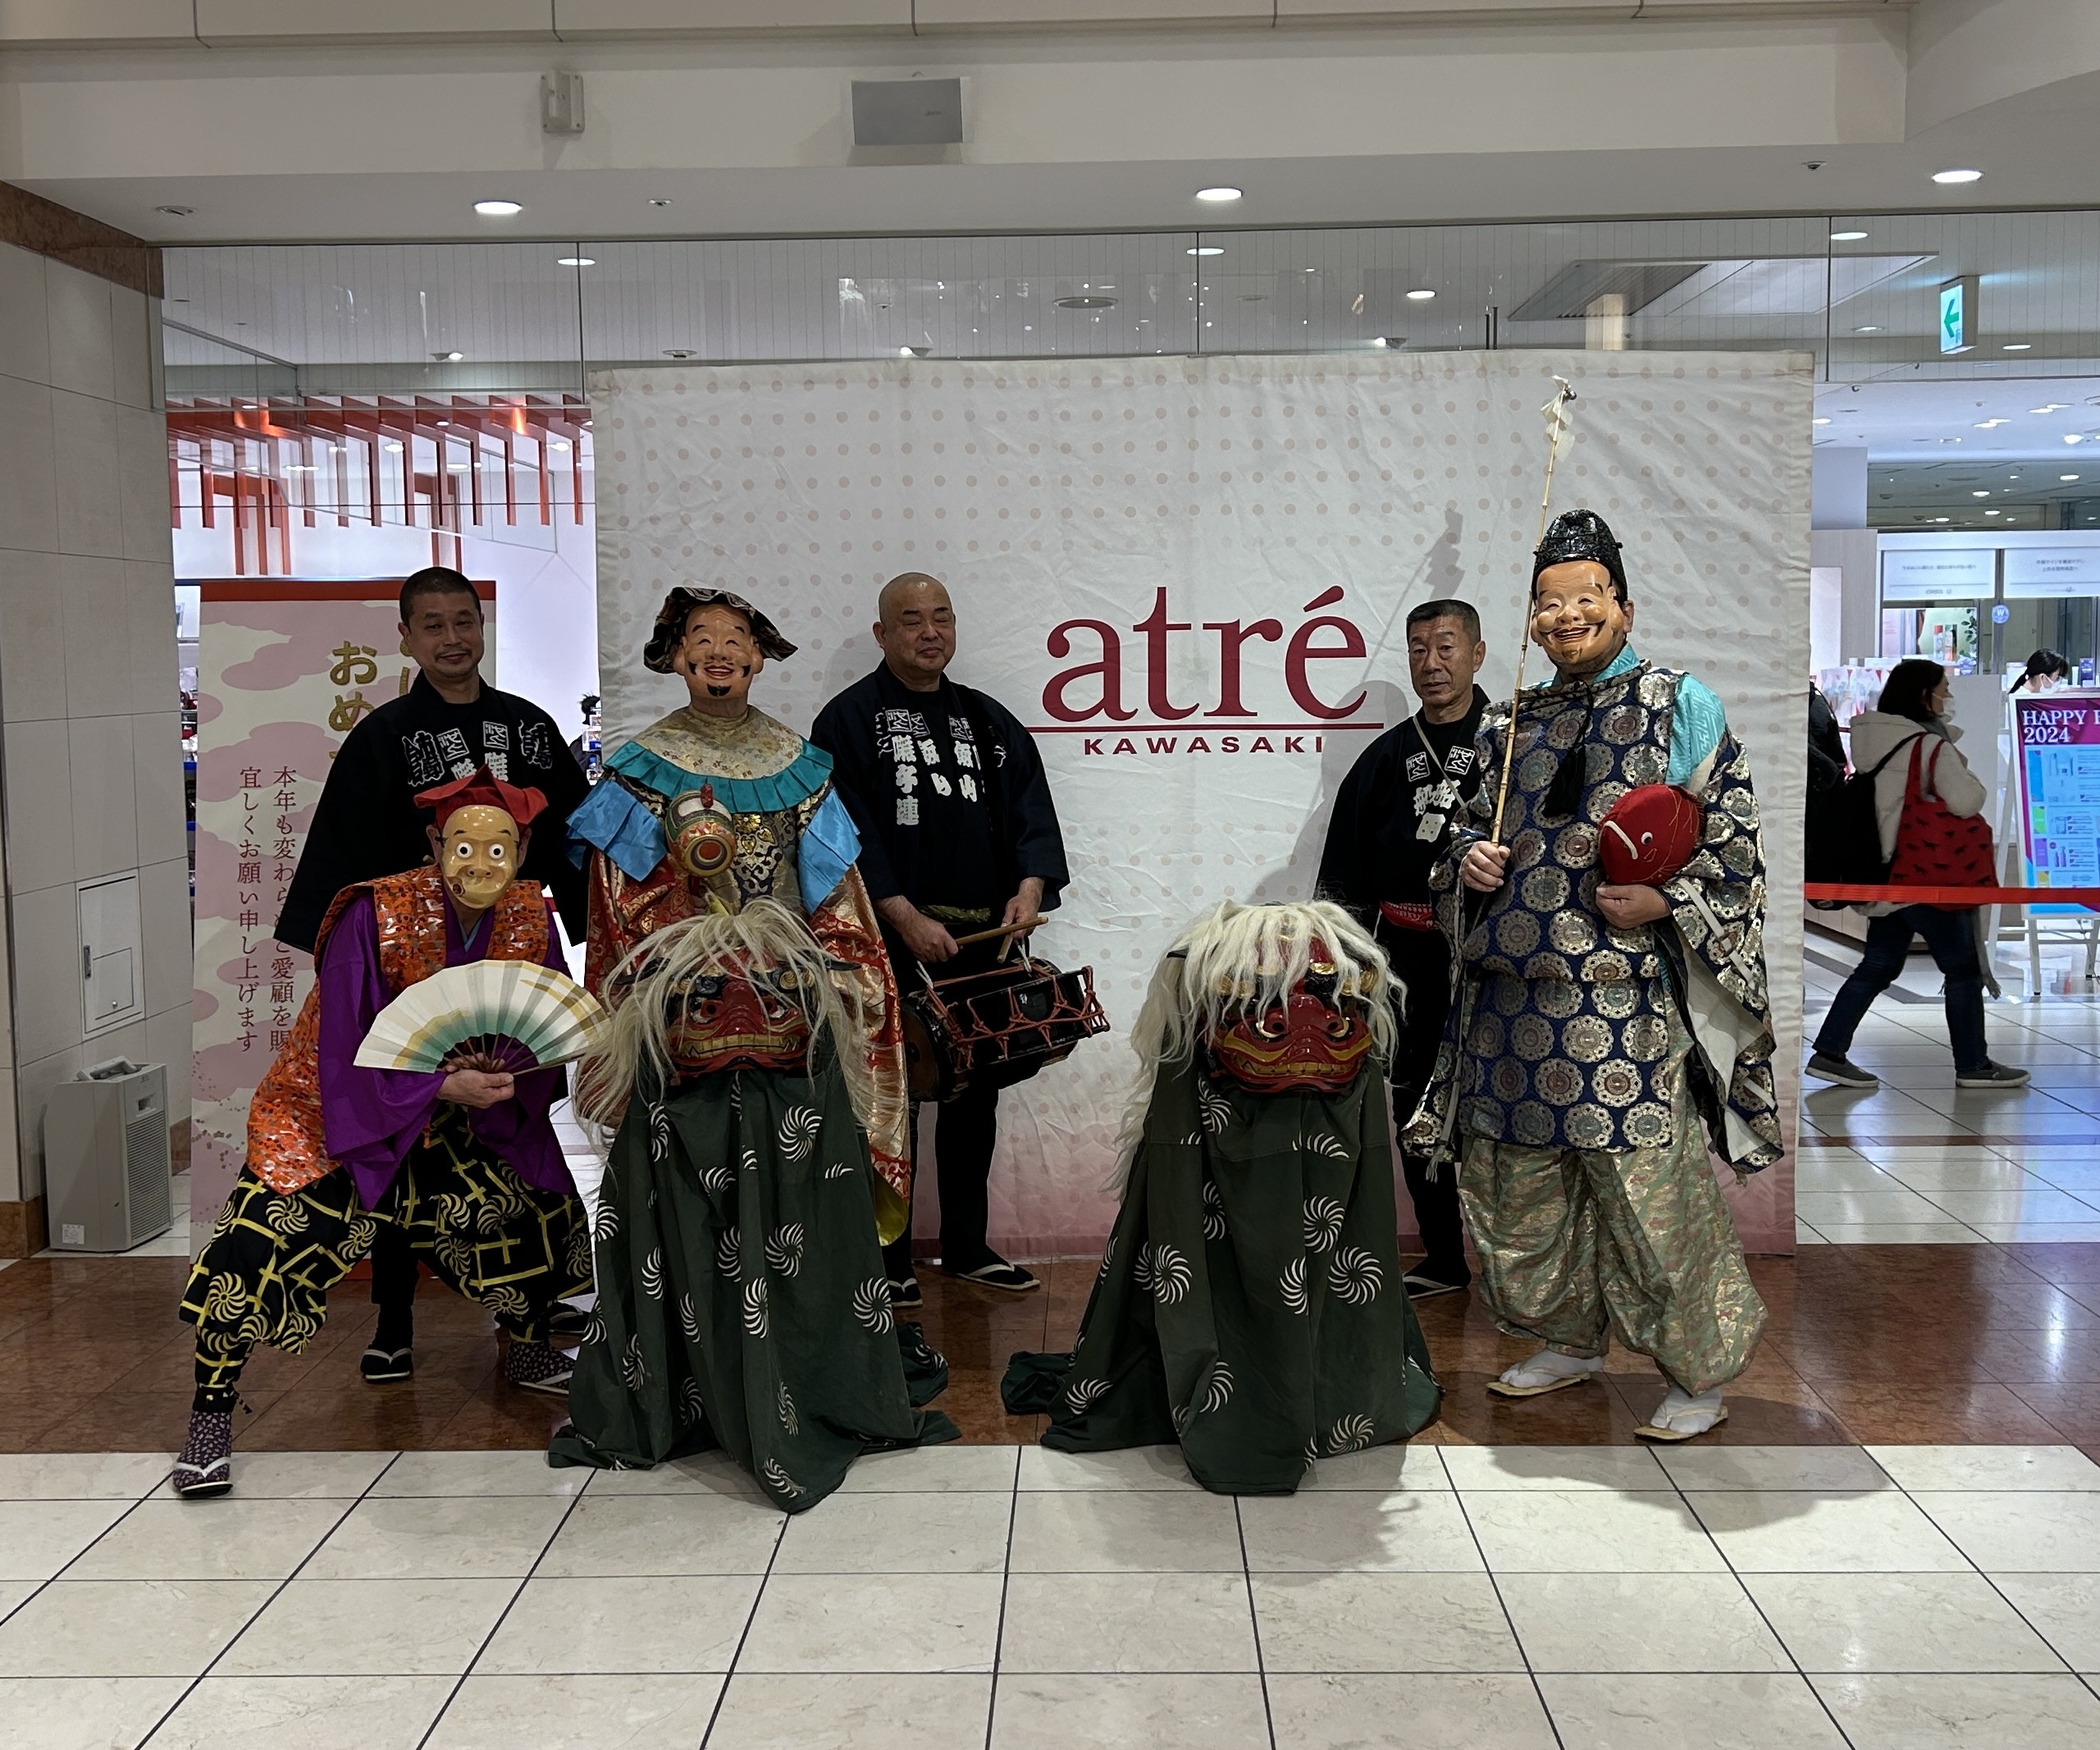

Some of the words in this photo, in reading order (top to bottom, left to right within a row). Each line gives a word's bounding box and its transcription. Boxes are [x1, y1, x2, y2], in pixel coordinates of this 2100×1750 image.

[1043, 586, 1367, 722] atré
[2022, 710, 2088, 725] HAPPY
[2024, 726, 2070, 742] 2024
[1084, 736, 1322, 755] KAWASAKI
[236, 766, 262, 1053] 宜しくお願い申し上げます
